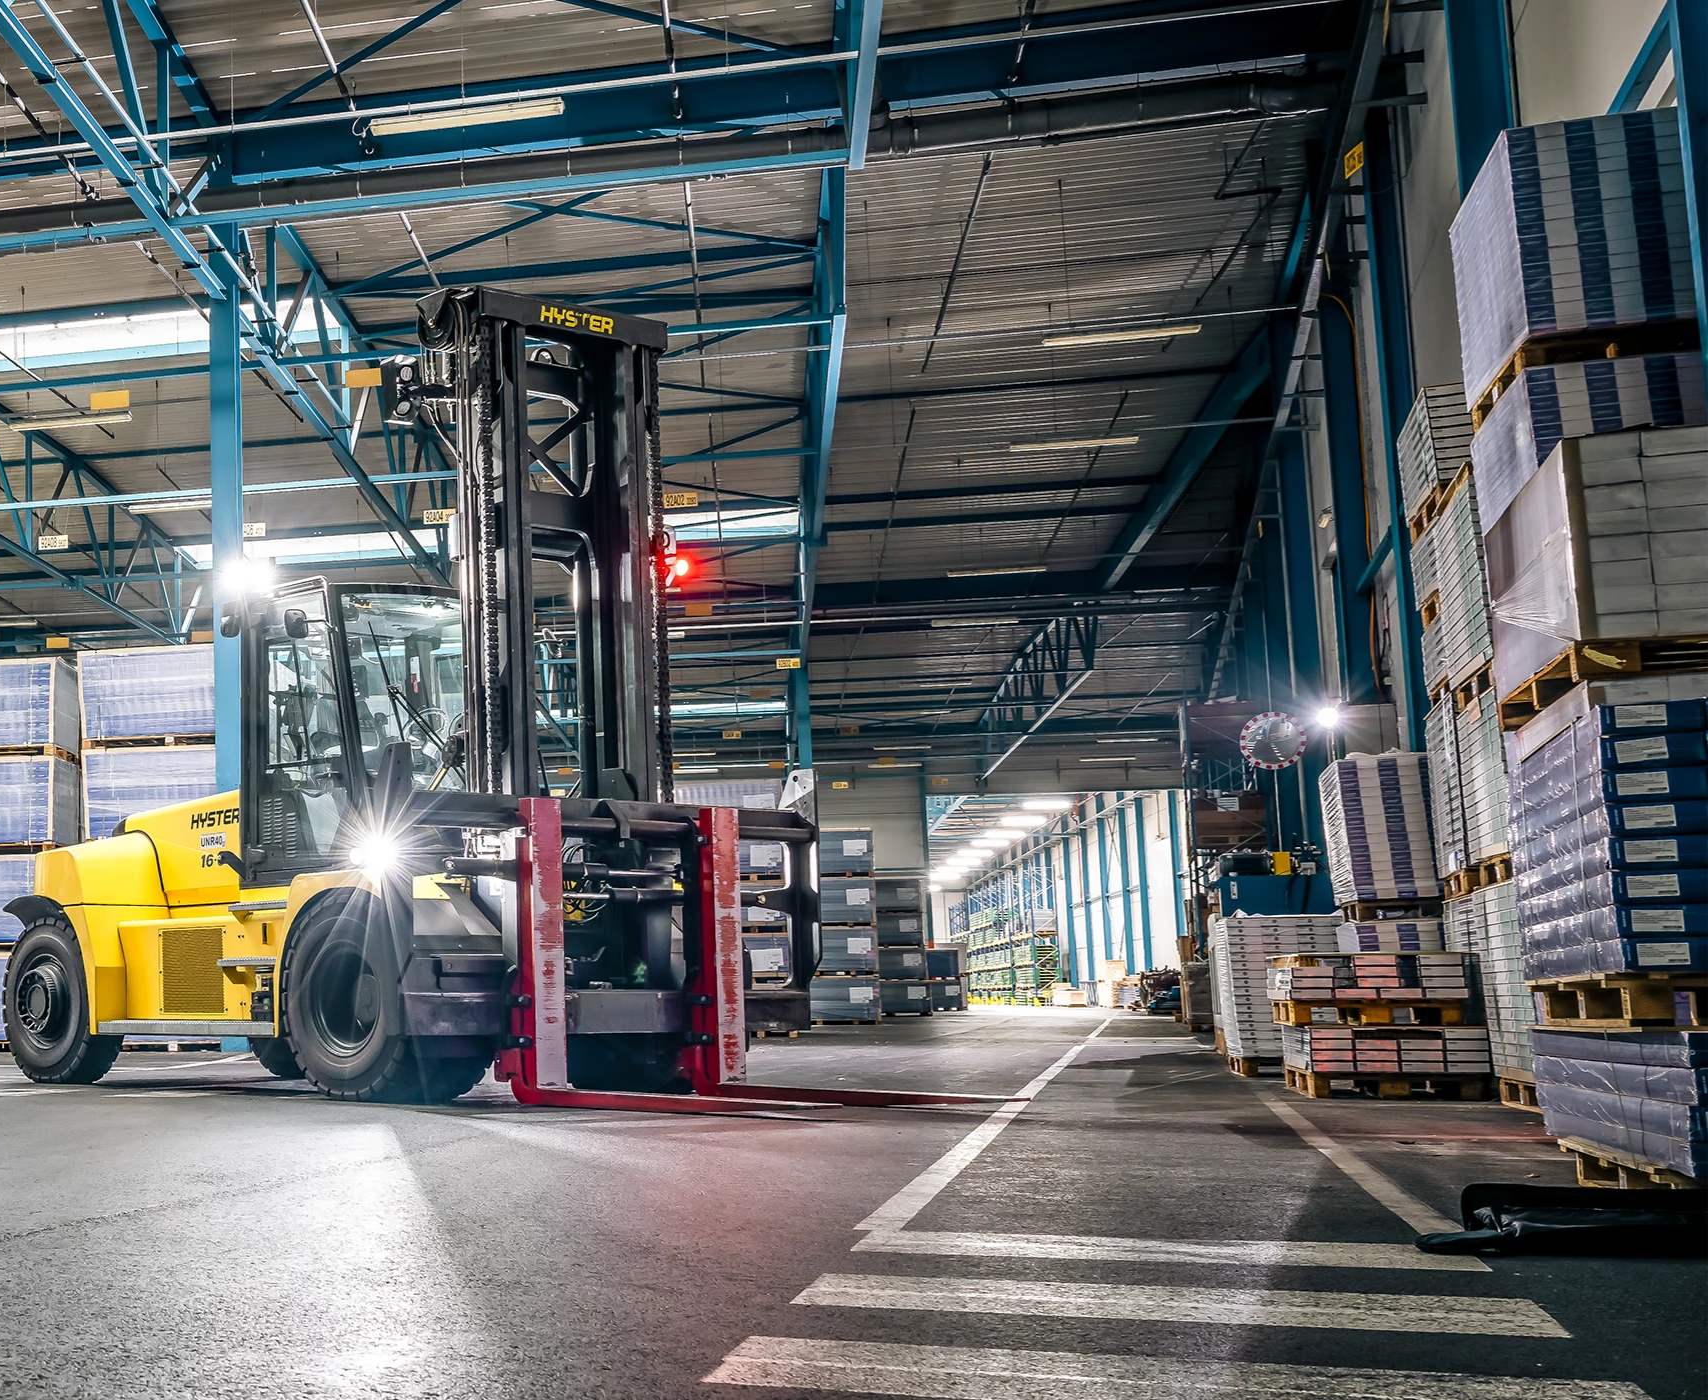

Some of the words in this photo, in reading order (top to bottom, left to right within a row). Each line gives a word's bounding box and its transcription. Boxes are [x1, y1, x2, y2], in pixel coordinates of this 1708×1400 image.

[540, 304, 614, 334] HYSTER
[666, 494, 684, 506] 92A02
[426, 510, 443, 523] 92A04
[190, 808, 239, 829] HYSTER
[201, 836, 222, 847] UNR40
